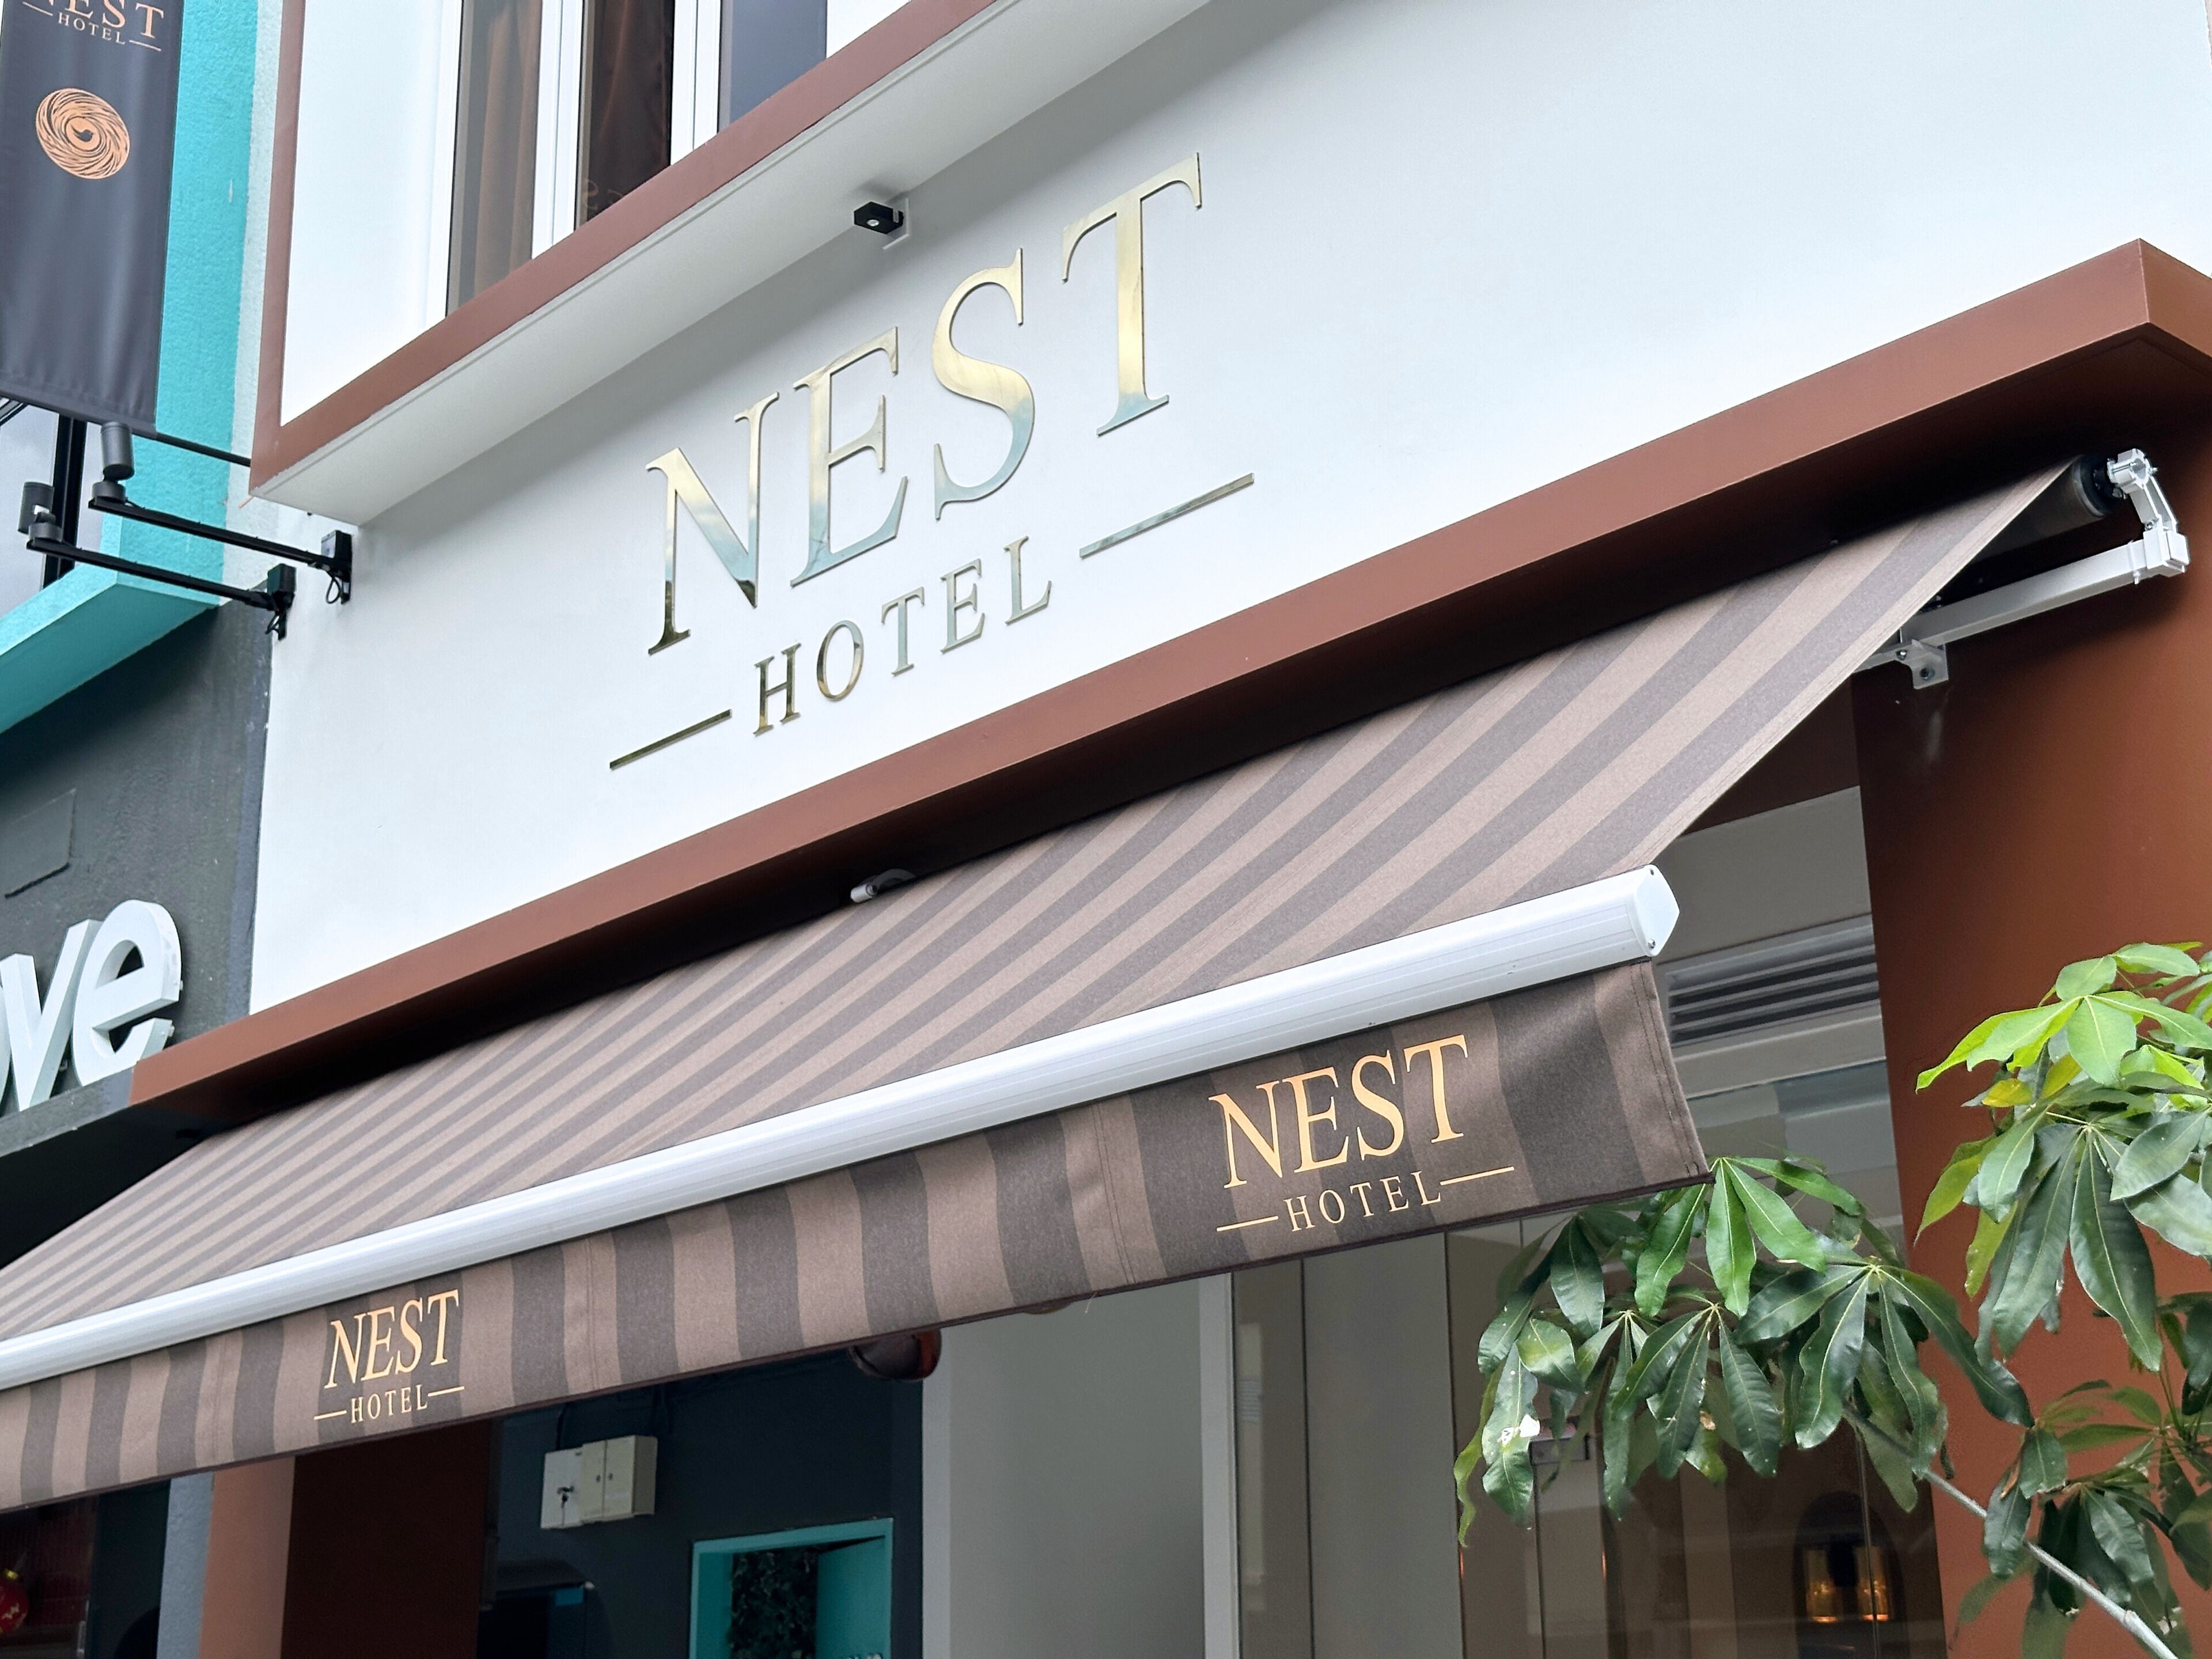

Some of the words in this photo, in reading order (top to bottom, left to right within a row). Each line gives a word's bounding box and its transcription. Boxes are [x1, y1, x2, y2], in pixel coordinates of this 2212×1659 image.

[48, 0, 164, 39] EST
[58, 12, 126, 44] HOTEL
[645, 151, 1202, 656] NEST
[753, 535, 1052, 737] HOTEL
[0, 899, 182, 1115] ve
[1208, 1034, 1468, 1188] NEST
[1283, 1170, 1441, 1232] HOTEL
[324, 1289, 460, 1389] NEST
[350, 1384, 428, 1423] HOTEL
